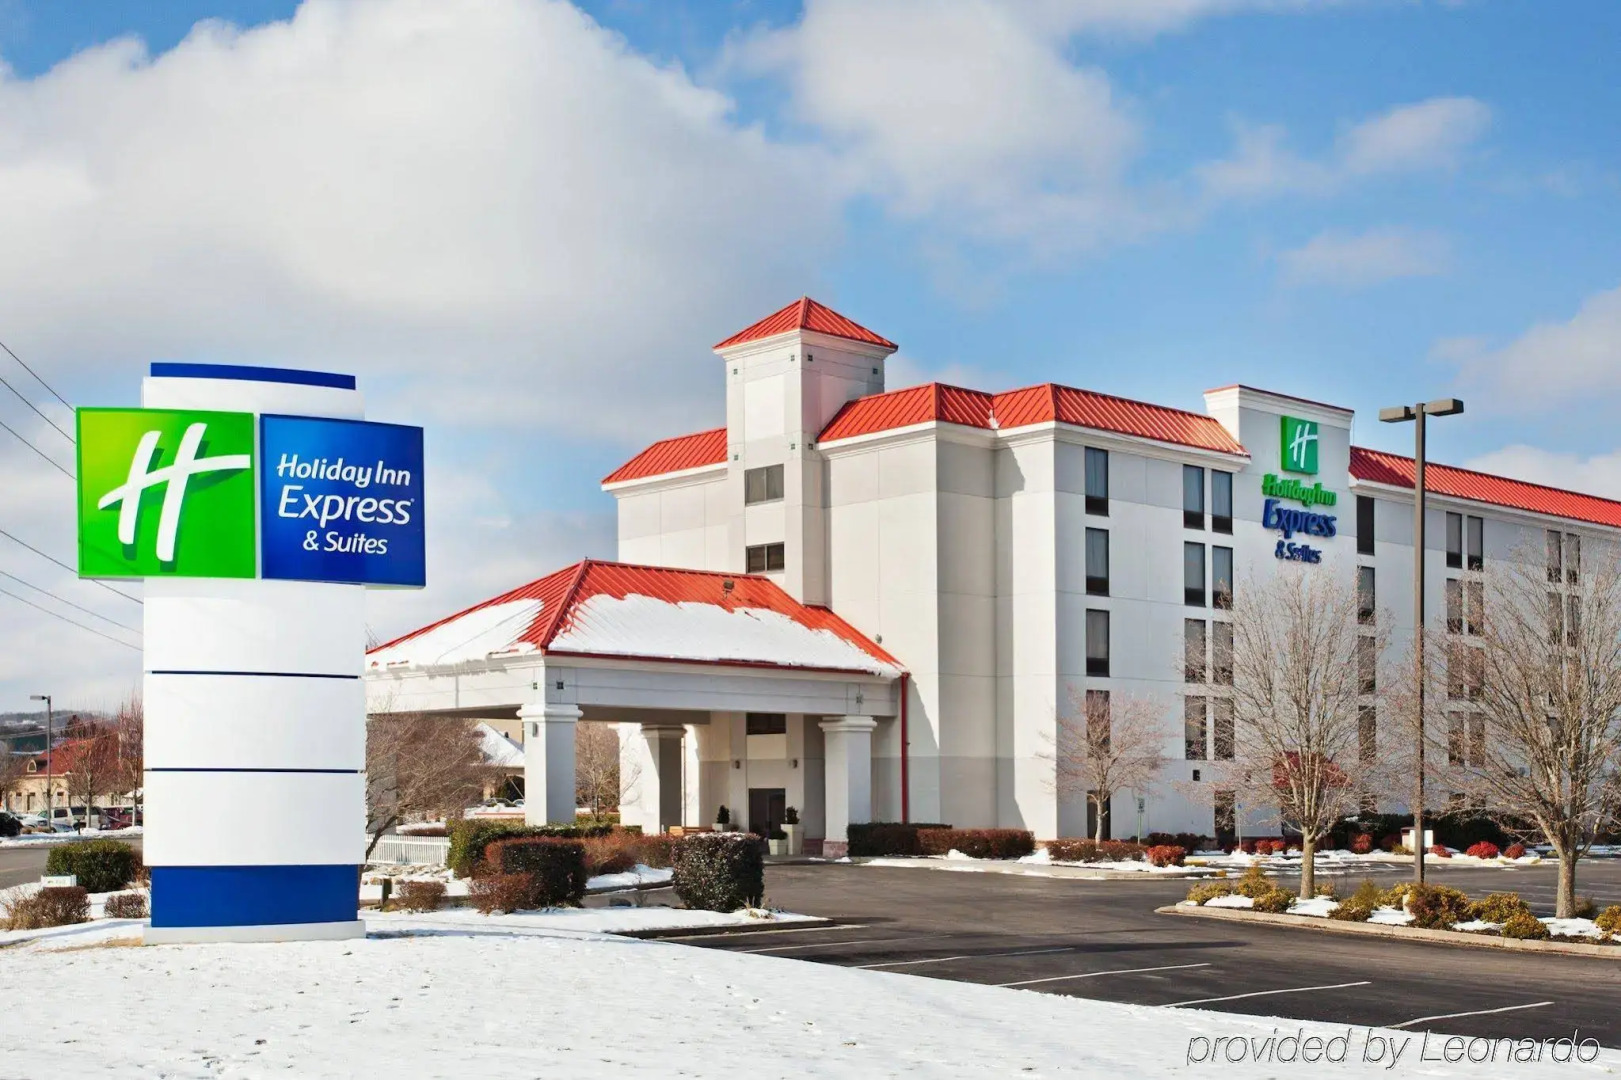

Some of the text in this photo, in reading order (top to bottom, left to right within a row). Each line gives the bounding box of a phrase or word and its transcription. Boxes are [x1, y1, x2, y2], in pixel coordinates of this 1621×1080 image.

[276, 453, 411, 488] Holiday Inn
[278, 484, 412, 528] Express
[1262, 473, 1337, 507] Holiday Inn
[1262, 499, 1337, 539] Express
[302, 530, 388, 555] & Suites
[1275, 540, 1285, 560] &
